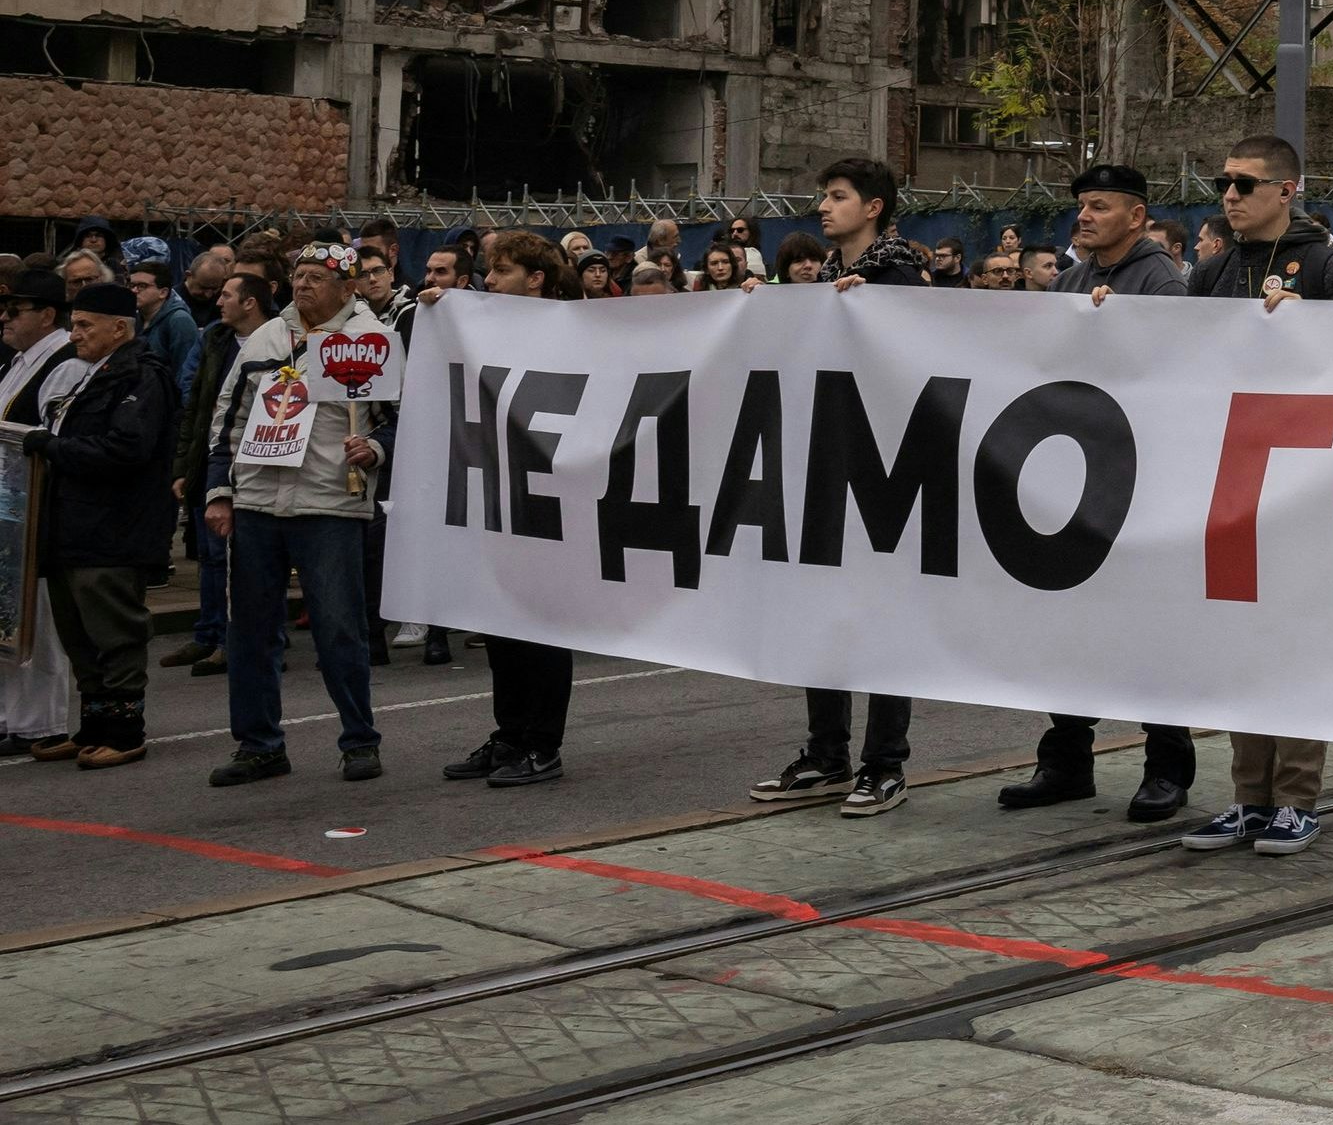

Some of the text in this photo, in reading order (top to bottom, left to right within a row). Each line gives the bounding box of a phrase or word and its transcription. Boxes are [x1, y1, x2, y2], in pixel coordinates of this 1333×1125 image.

[321, 343, 388, 366] PUMPAJ
[253, 423, 301, 442] НИСИ
[241, 438, 305, 457] НАДЛЕЖАН
[445, 362, 590, 542] НЕ
[597, 369, 1138, 592] ДАМО
